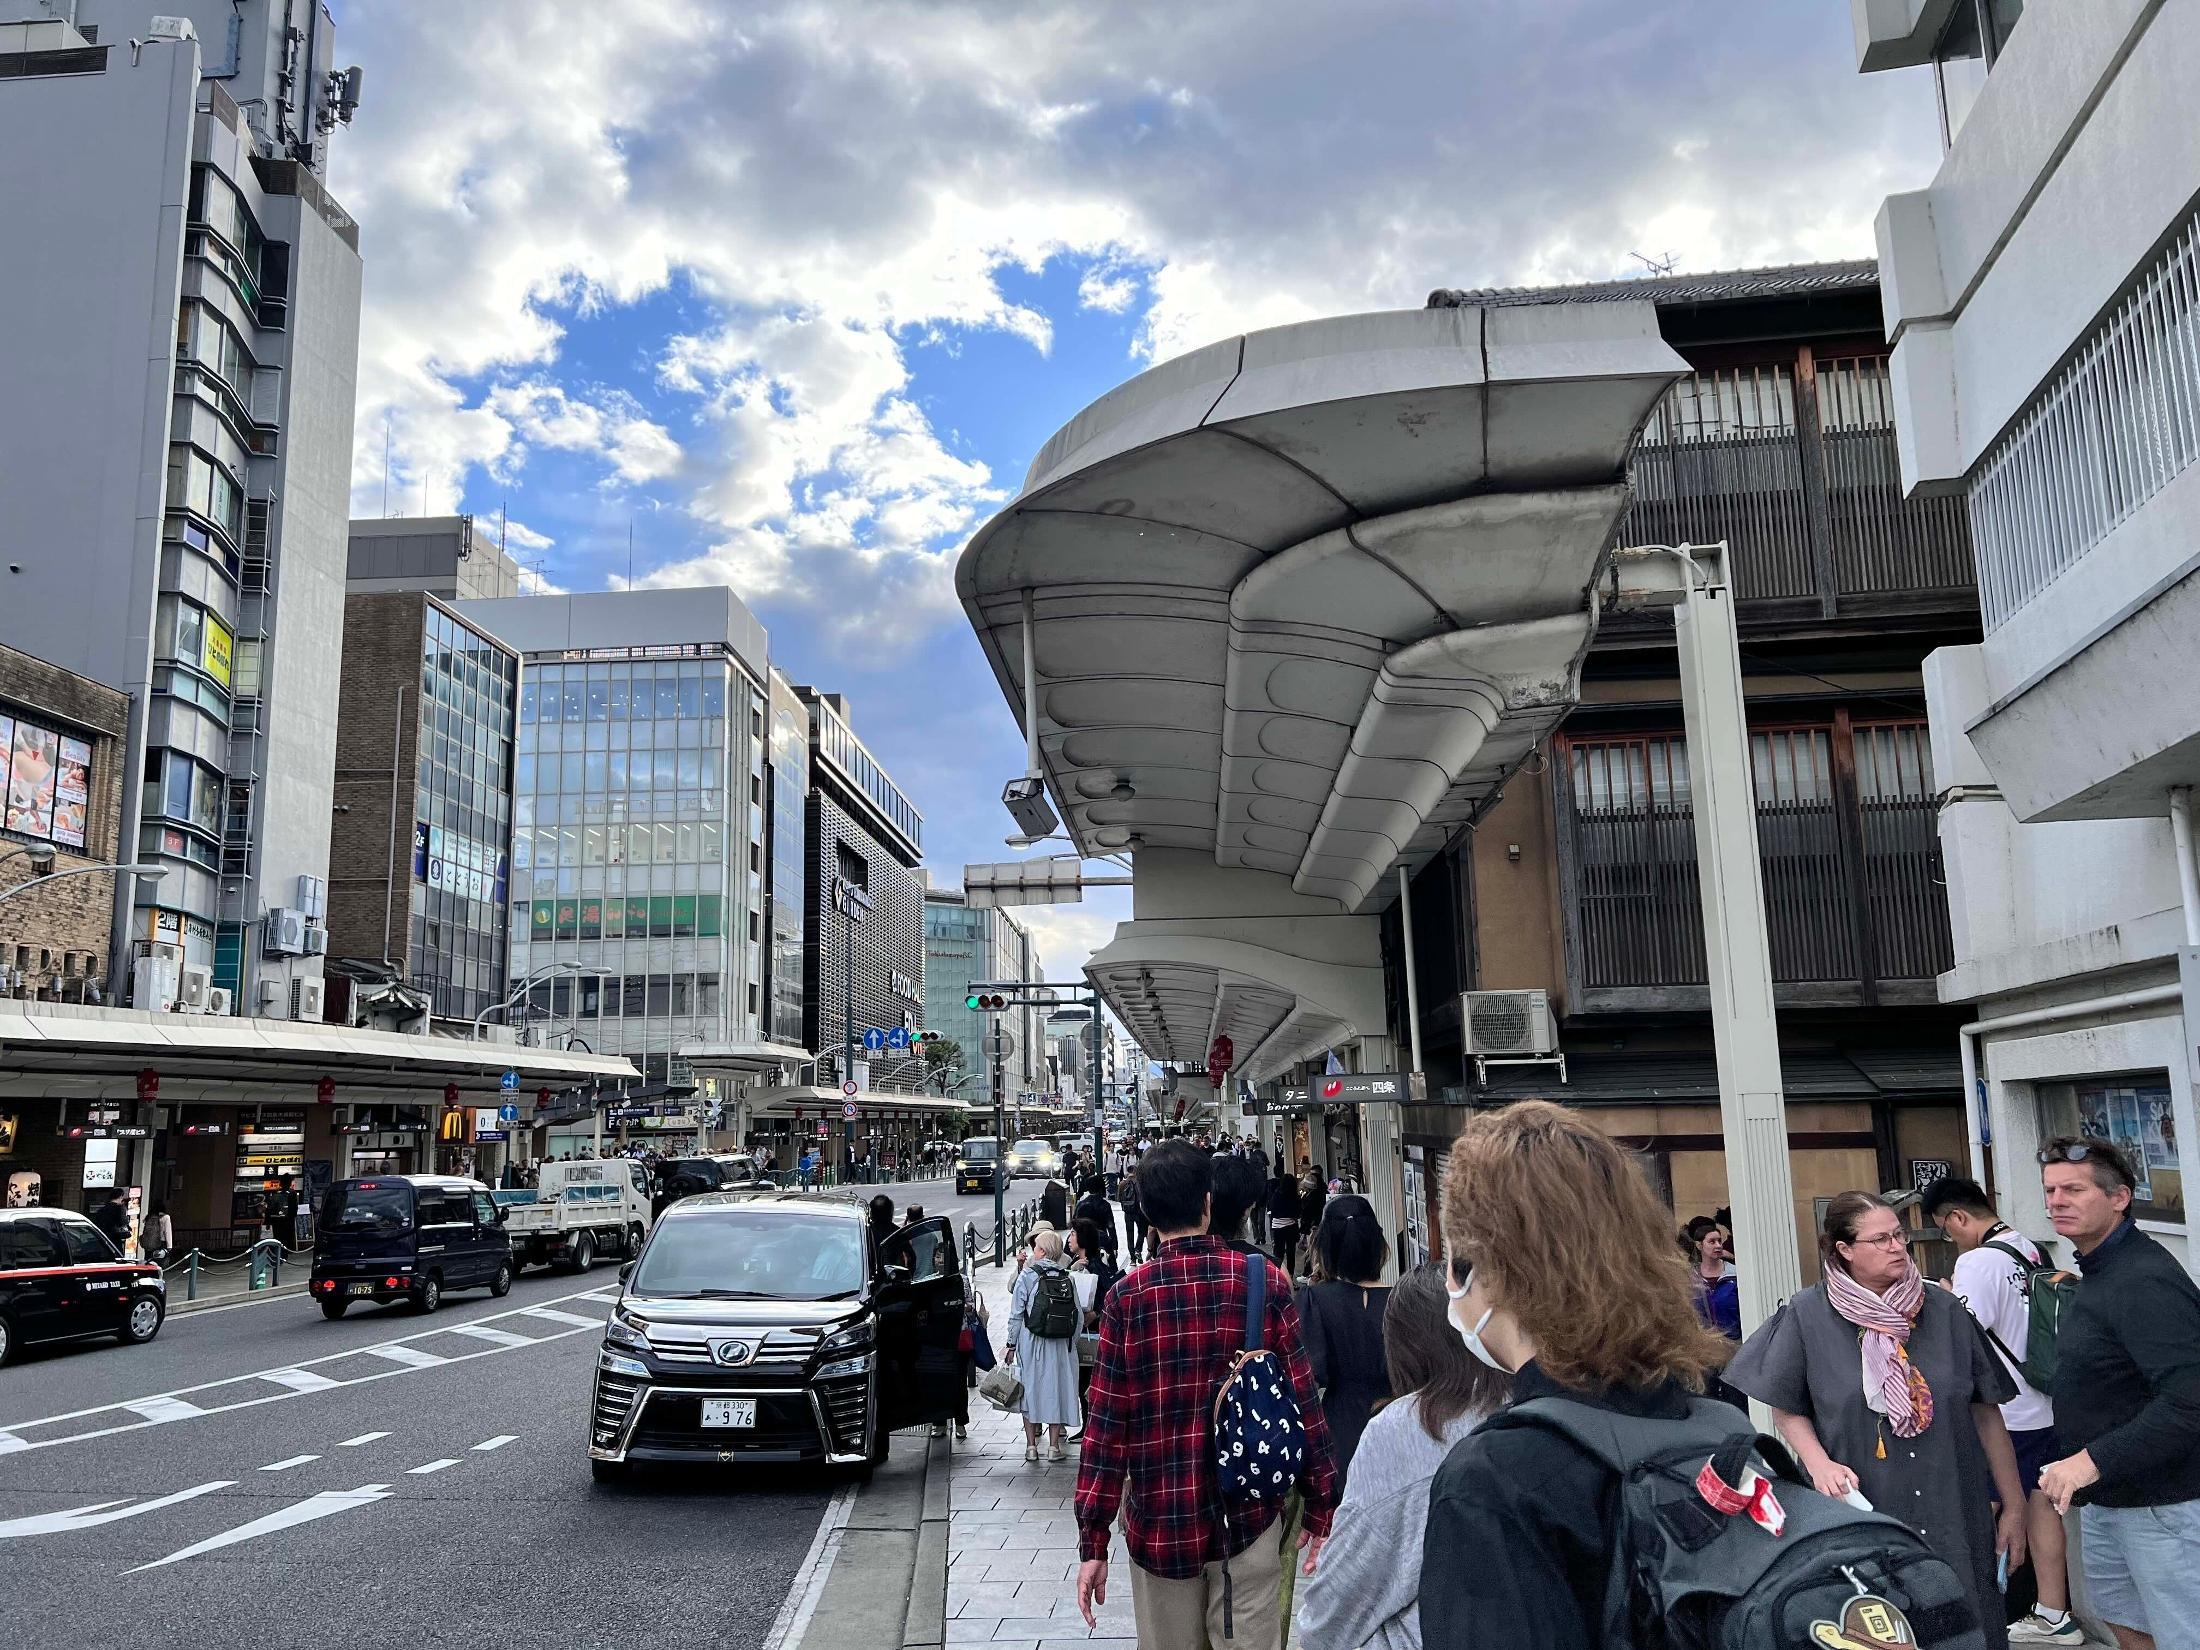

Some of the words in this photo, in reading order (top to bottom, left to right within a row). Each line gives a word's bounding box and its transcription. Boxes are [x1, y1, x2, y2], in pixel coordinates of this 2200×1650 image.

[414, 830, 425, 848] 2F
[158, 909, 179, 930] 2階
[1372, 1080, 1396, 1094] 四条
[731, 1401, 745, 1410] 330
[1232, 1441, 1244, 1458] 9
[1258, 1440, 1270, 1455] 4
[1218, 1449, 1230, 1467] 2
[1272, 1470, 1283, 1484] 0
